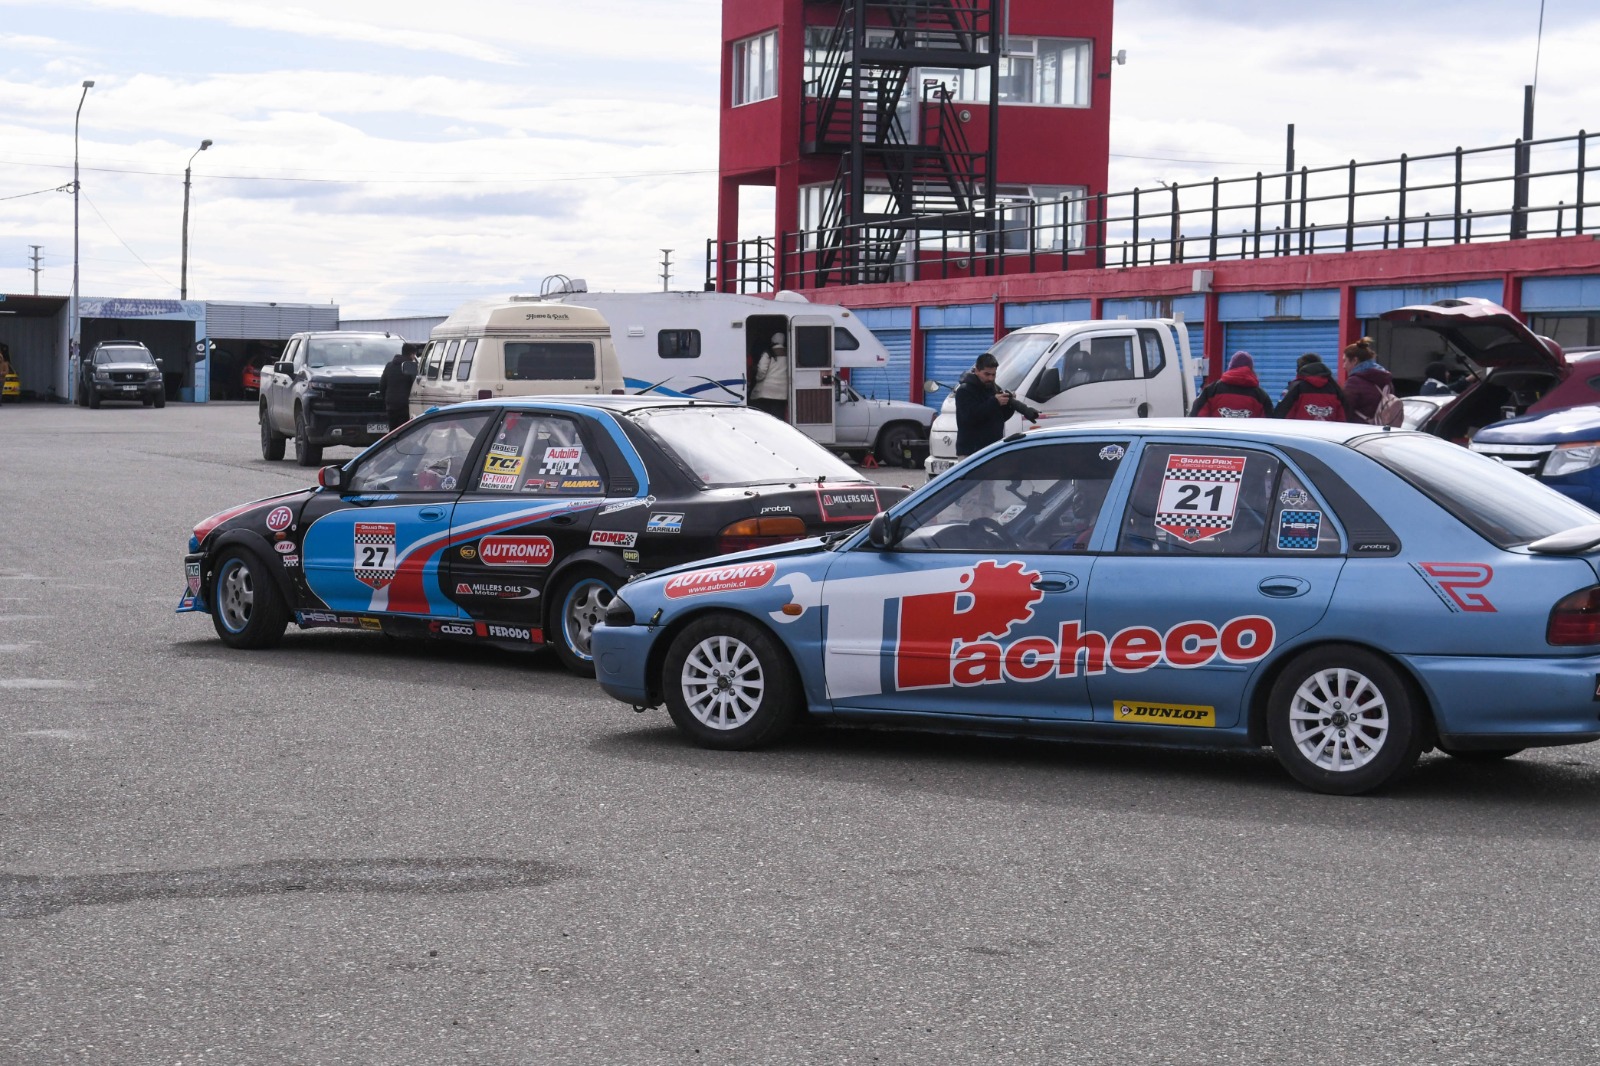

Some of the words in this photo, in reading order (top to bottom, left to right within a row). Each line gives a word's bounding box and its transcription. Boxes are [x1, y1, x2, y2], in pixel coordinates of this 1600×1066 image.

[547, 448, 579, 459] Autolite
[1180, 457, 1210, 465] GRAND
[1212, 458, 1233, 466] PRIX
[482, 473, 517, 484] G-FORCE
[561, 480, 600, 488] MANNOL
[833, 494, 860, 504] MILLERS
[860, 494, 875, 503] OILS
[1174, 484, 1224, 512] 21
[760, 505, 793, 514] proton
[269, 509, 289, 526] STP
[1282, 522, 1318, 530] HSR
[592, 532, 626, 543] COMP
[482, 544, 550, 557] AUTRONIX
[624, 552, 638, 560] OMP
[361, 546, 389, 567] 27
[186, 565, 200, 577] TAG
[667, 564, 772, 590] AUTRONIX
[472, 584, 503, 592] MILLERS
[504, 585, 522, 593] OILS
[688, 580, 747, 594] www.autronix.cl
[440, 625, 473, 635] CUSCO
[895, 559, 1277, 692] Pacheco
[489, 625, 530, 639] FERODO
[1134, 706, 1209, 720] DUNLOP
